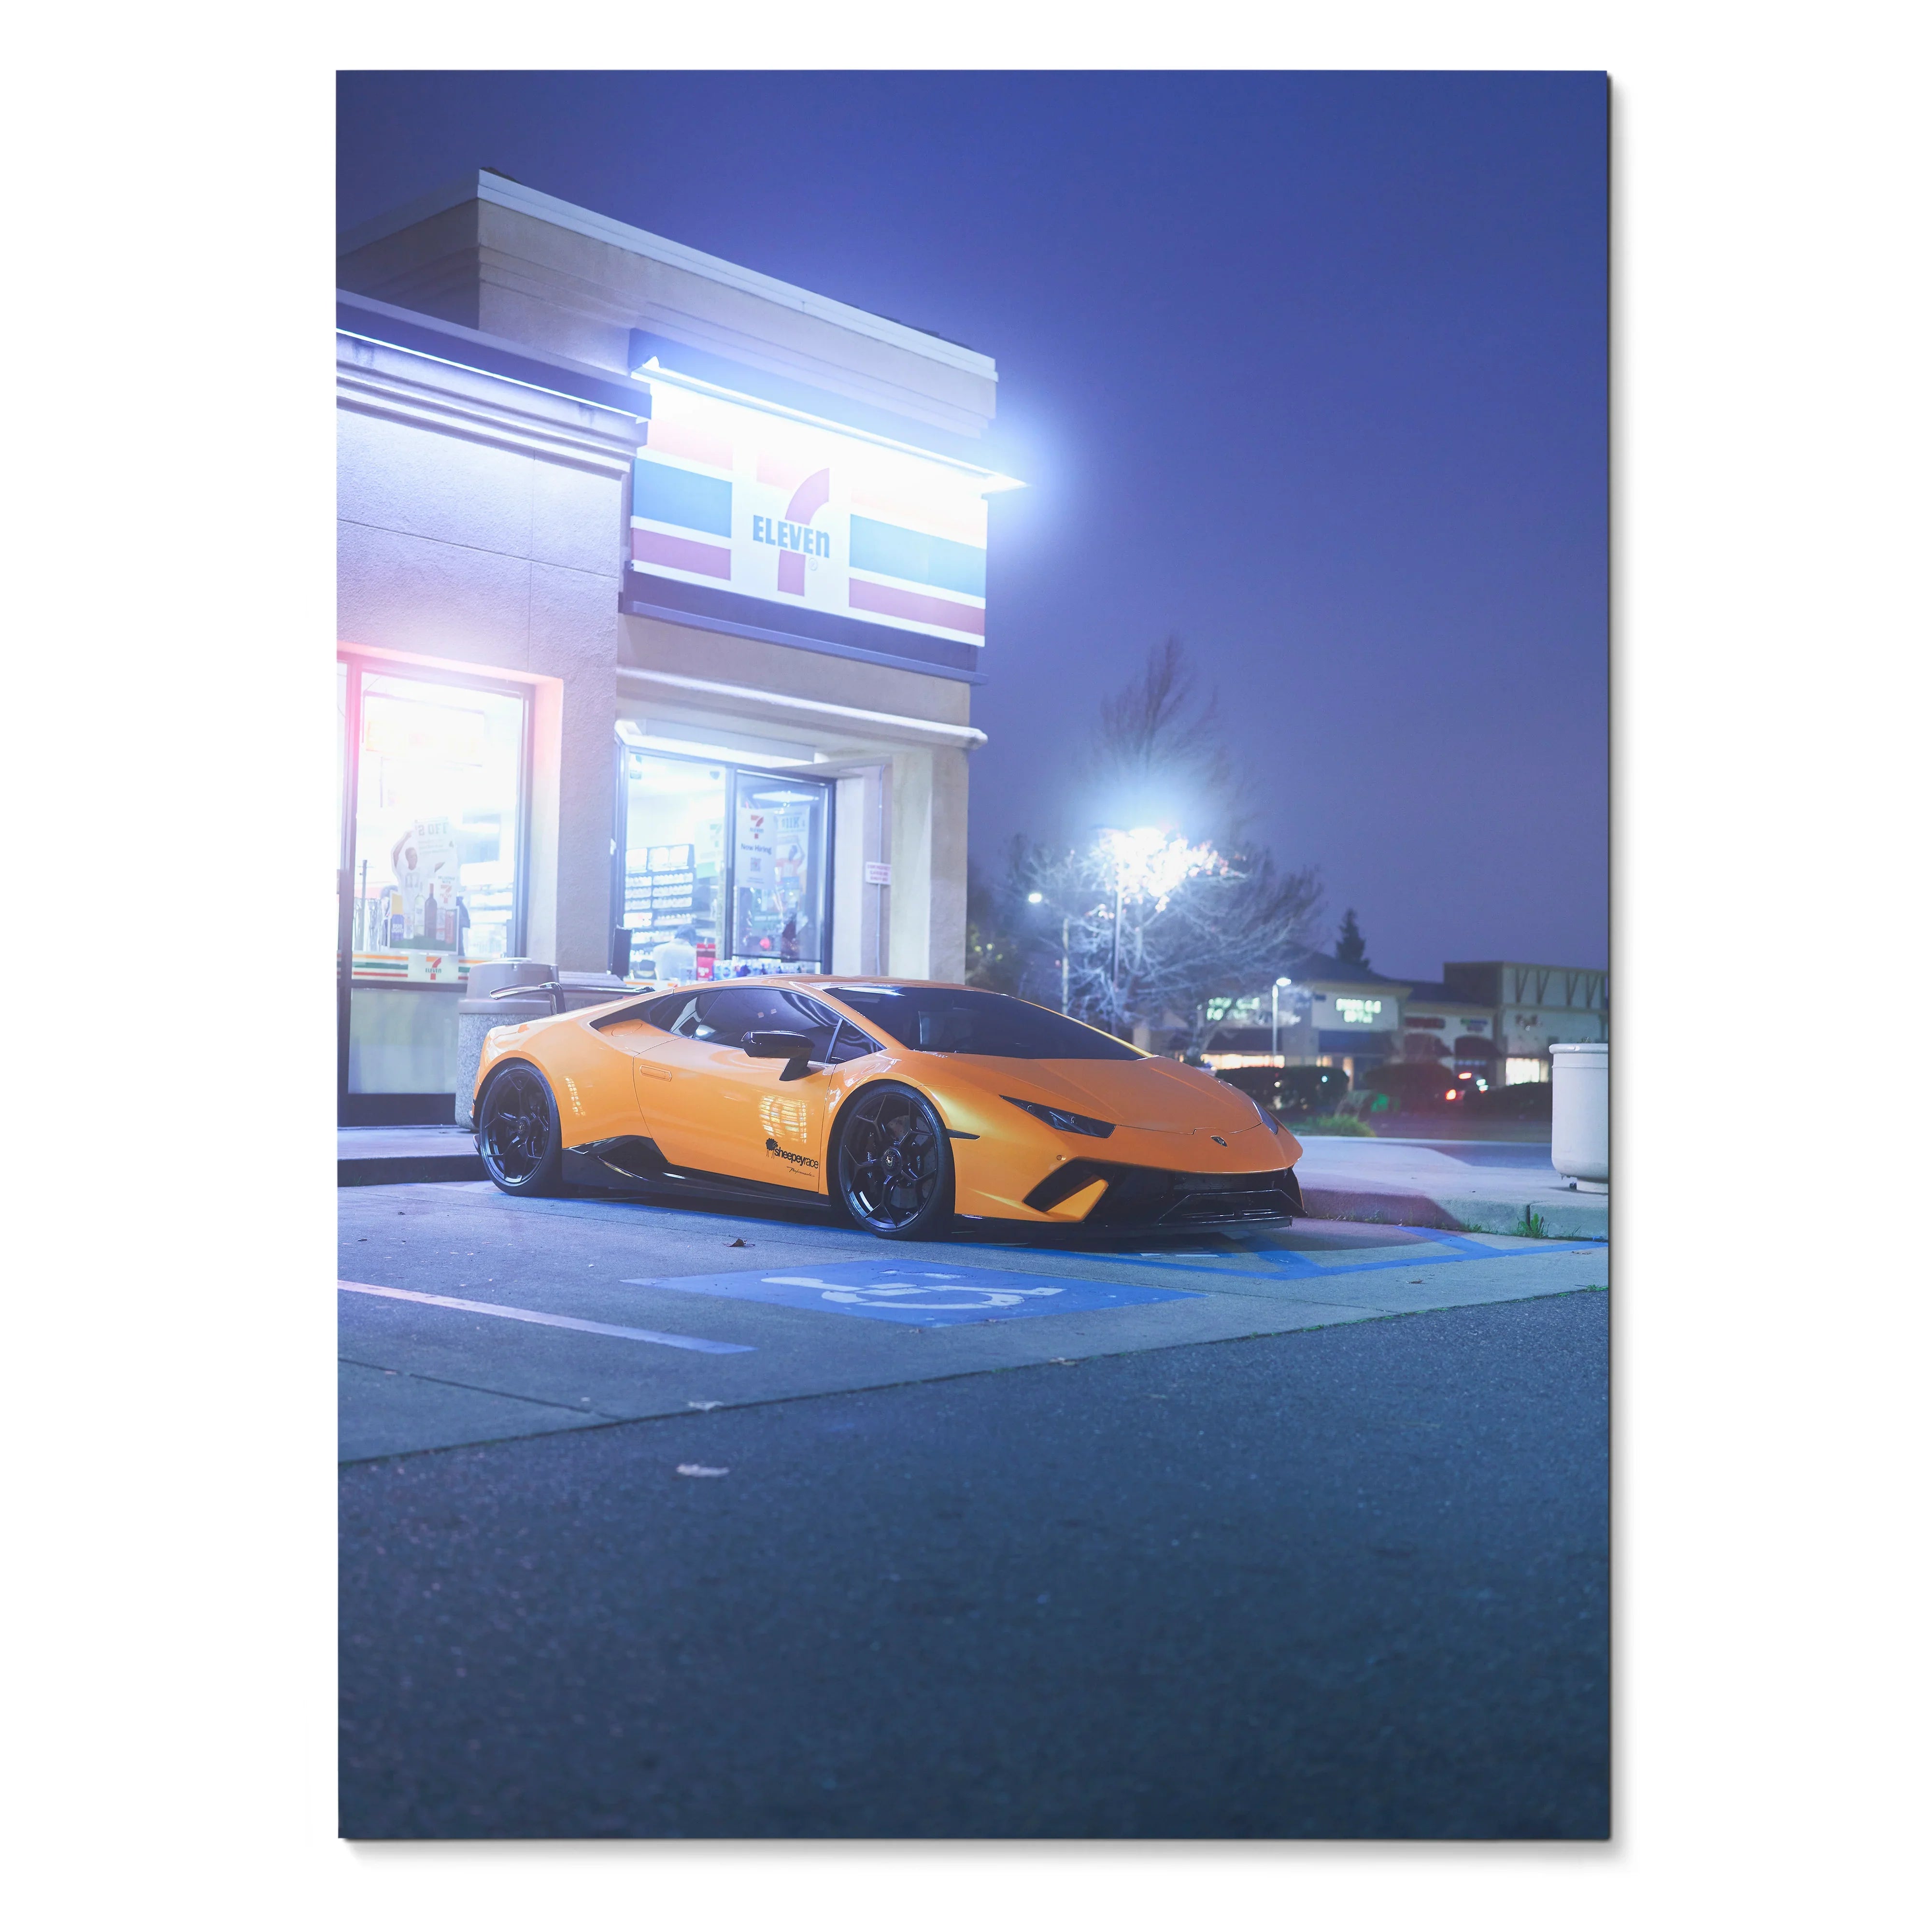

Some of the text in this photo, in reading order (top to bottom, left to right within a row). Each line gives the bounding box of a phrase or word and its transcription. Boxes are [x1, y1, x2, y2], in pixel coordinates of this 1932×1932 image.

[756, 451, 830, 597] 7
[755, 844, 772, 854] Hiring
[426, 956, 441, 980] 7
[774, 1147, 819, 1169] sheepeyrace
